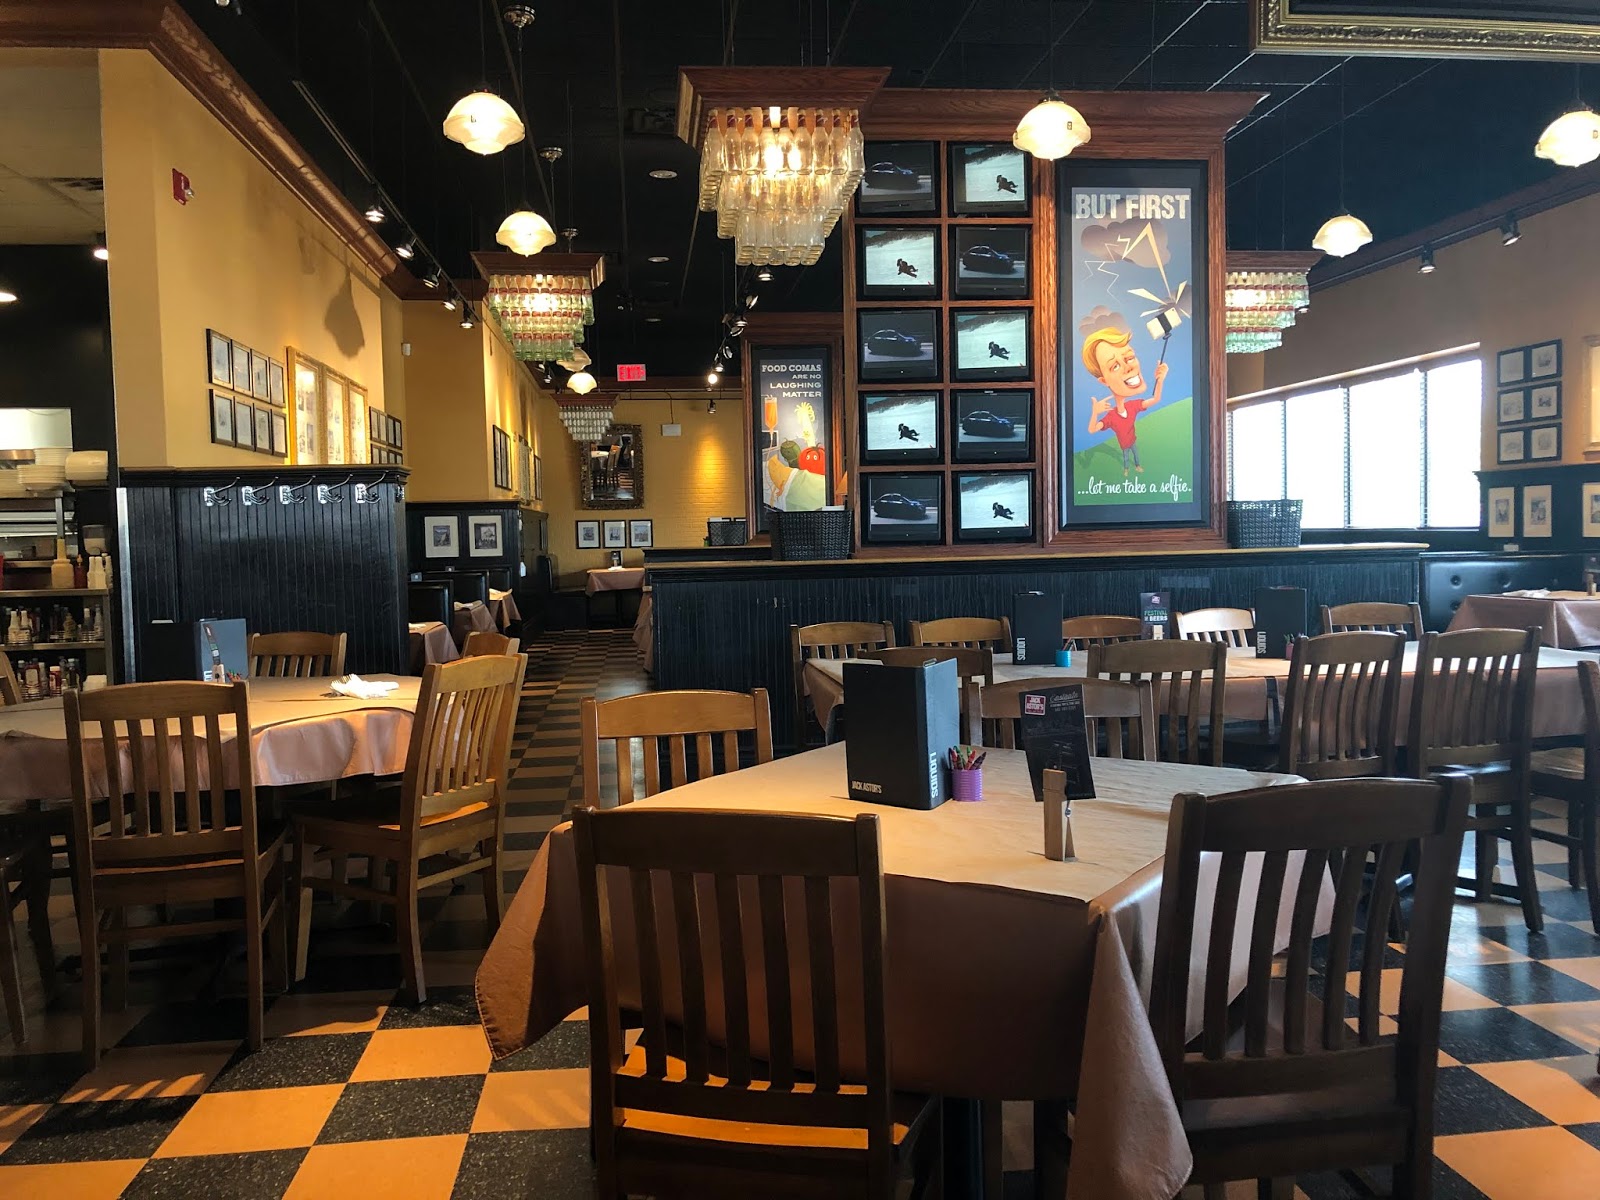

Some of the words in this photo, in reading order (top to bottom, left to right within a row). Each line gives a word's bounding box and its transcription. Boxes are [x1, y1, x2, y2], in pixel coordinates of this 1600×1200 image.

[1075, 194, 1120, 219] BUT
[1125, 194, 1190, 219] FIRST
[761, 364, 787, 373] FOOD
[788, 364, 822, 372] COMAS
[1105, 483, 1121, 494] me
[1122, 476, 1147, 493] take
[1149, 483, 1158, 493] a
[1159, 474, 1192, 502] selfie.
[851, 780, 864, 791] JACK
[863, 782, 882, 794] ASTOR'S
[929, 751, 939, 799] LIQUIDS
